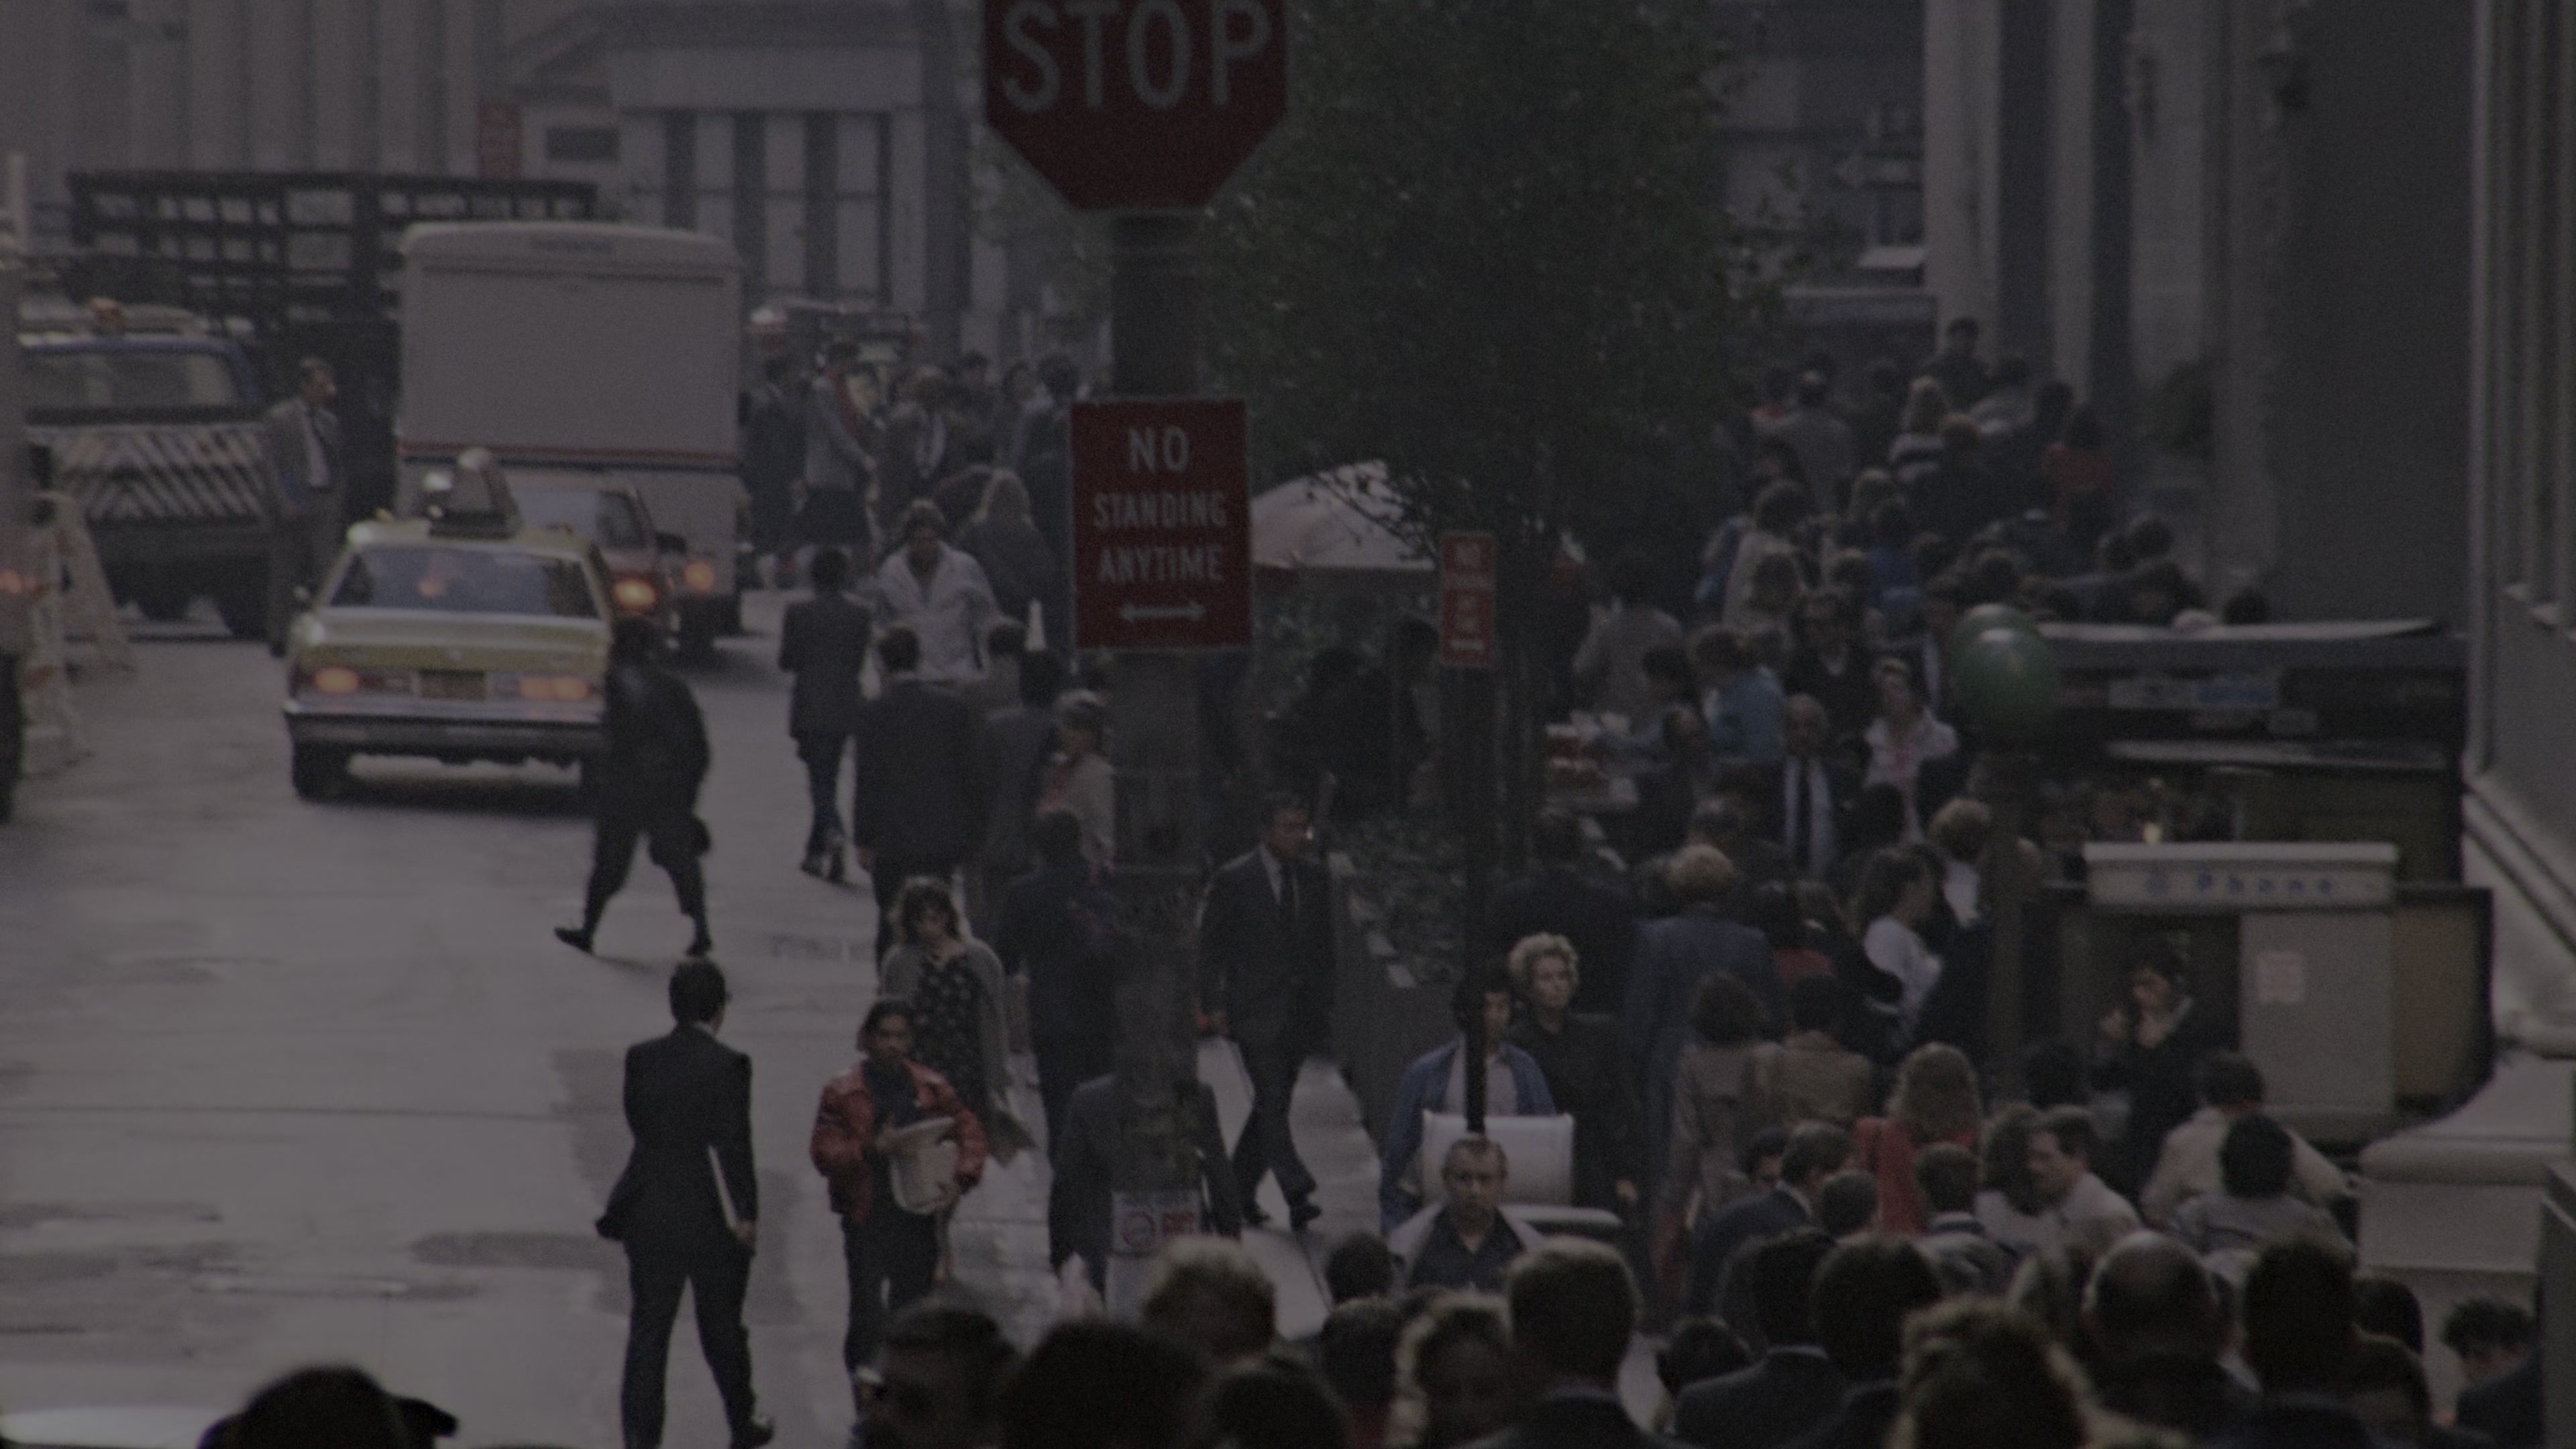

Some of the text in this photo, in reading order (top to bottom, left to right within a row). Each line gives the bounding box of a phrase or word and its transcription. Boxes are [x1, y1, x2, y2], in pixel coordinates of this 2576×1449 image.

[1003, 0, 1271, 112] STOP
[1128, 426, 1189, 472] NO
[1095, 492, 1226, 529] STANDING
[1098, 545, 1222, 582] ANYTIME
